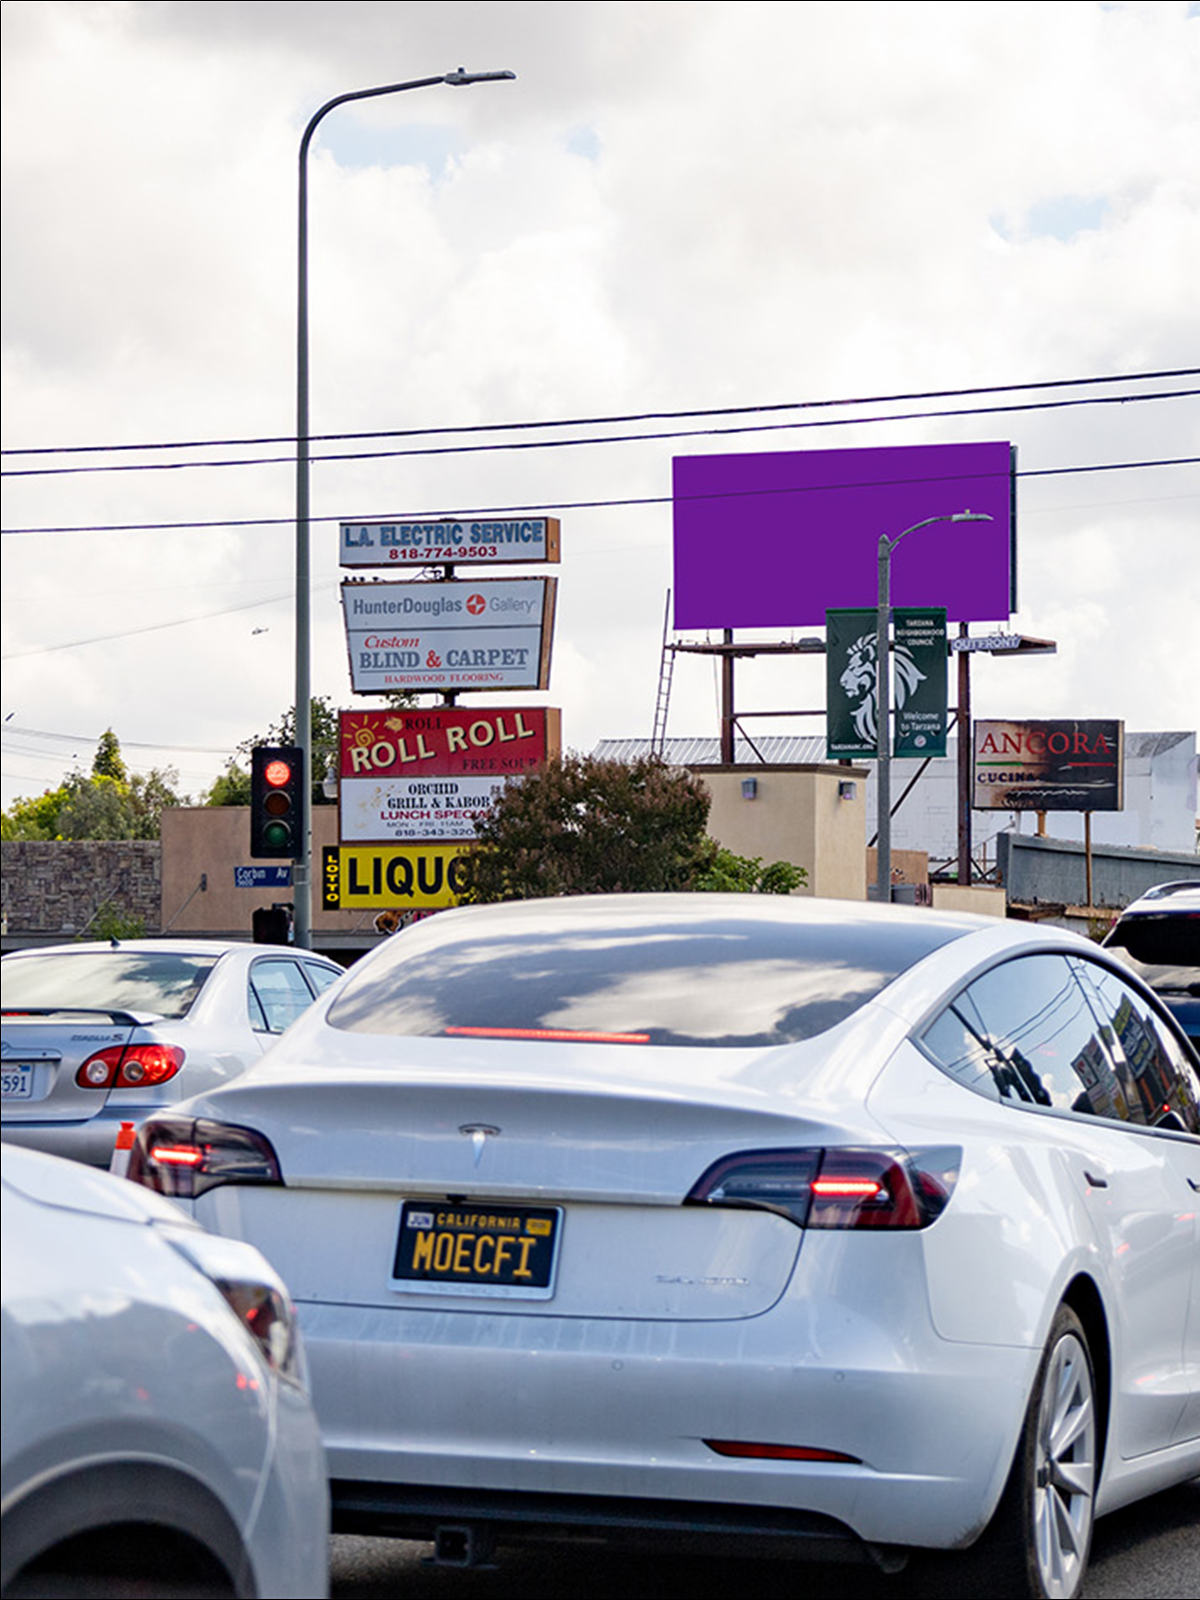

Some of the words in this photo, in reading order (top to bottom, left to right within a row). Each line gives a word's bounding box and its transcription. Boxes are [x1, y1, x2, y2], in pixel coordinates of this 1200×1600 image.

[344, 527, 374, 548] L.A.
[380, 523, 463, 546] ELECTRIC
[470, 521, 543, 544] SERVICE
[389, 546, 497, 560] 818-774-9503
[489, 597, 533, 614] Gallery
[364, 635, 420, 649] Custom
[359, 651, 420, 669] BLIND
[426, 649, 442, 668] &
[446, 648, 529, 667] CARPET
[384, 674, 445, 684] HARDWOOD
[450, 673, 504, 683] FLOORING
[903, 711, 939, 720] Welcome
[901, 722, 910, 731] to
[911, 722, 941, 731] Tarzana
[350, 734, 436, 773] ROLL
[446, 713, 535, 753] ROLL
[978, 731, 1111, 754] ANCORA
[462, 757, 497, 770] FREE
[408, 783, 459, 795] ORCHID
[387, 797, 428, 809] GRILL
[431, 797, 441, 809] &
[445, 796, 490, 809] KABOB
[380, 810, 431, 820] LUNCH
[434, 809, 489, 820] SPECIA
[395, 828, 476, 837] 818-343-320
[237, 867, 266, 879] Corbin
[276, 867, 288, 878] Av
[326, 855, 339, 902] LOTTO
[348, 857, 472, 898] LIQUO
[111, 1033, 124, 1042] S
[2, 1075, 26, 1092] 591
[409, 1213, 431, 1226] JUN
[436, 1212, 521, 1229] CALIFORNIA
[412, 1231, 537, 1278] MOECFI
